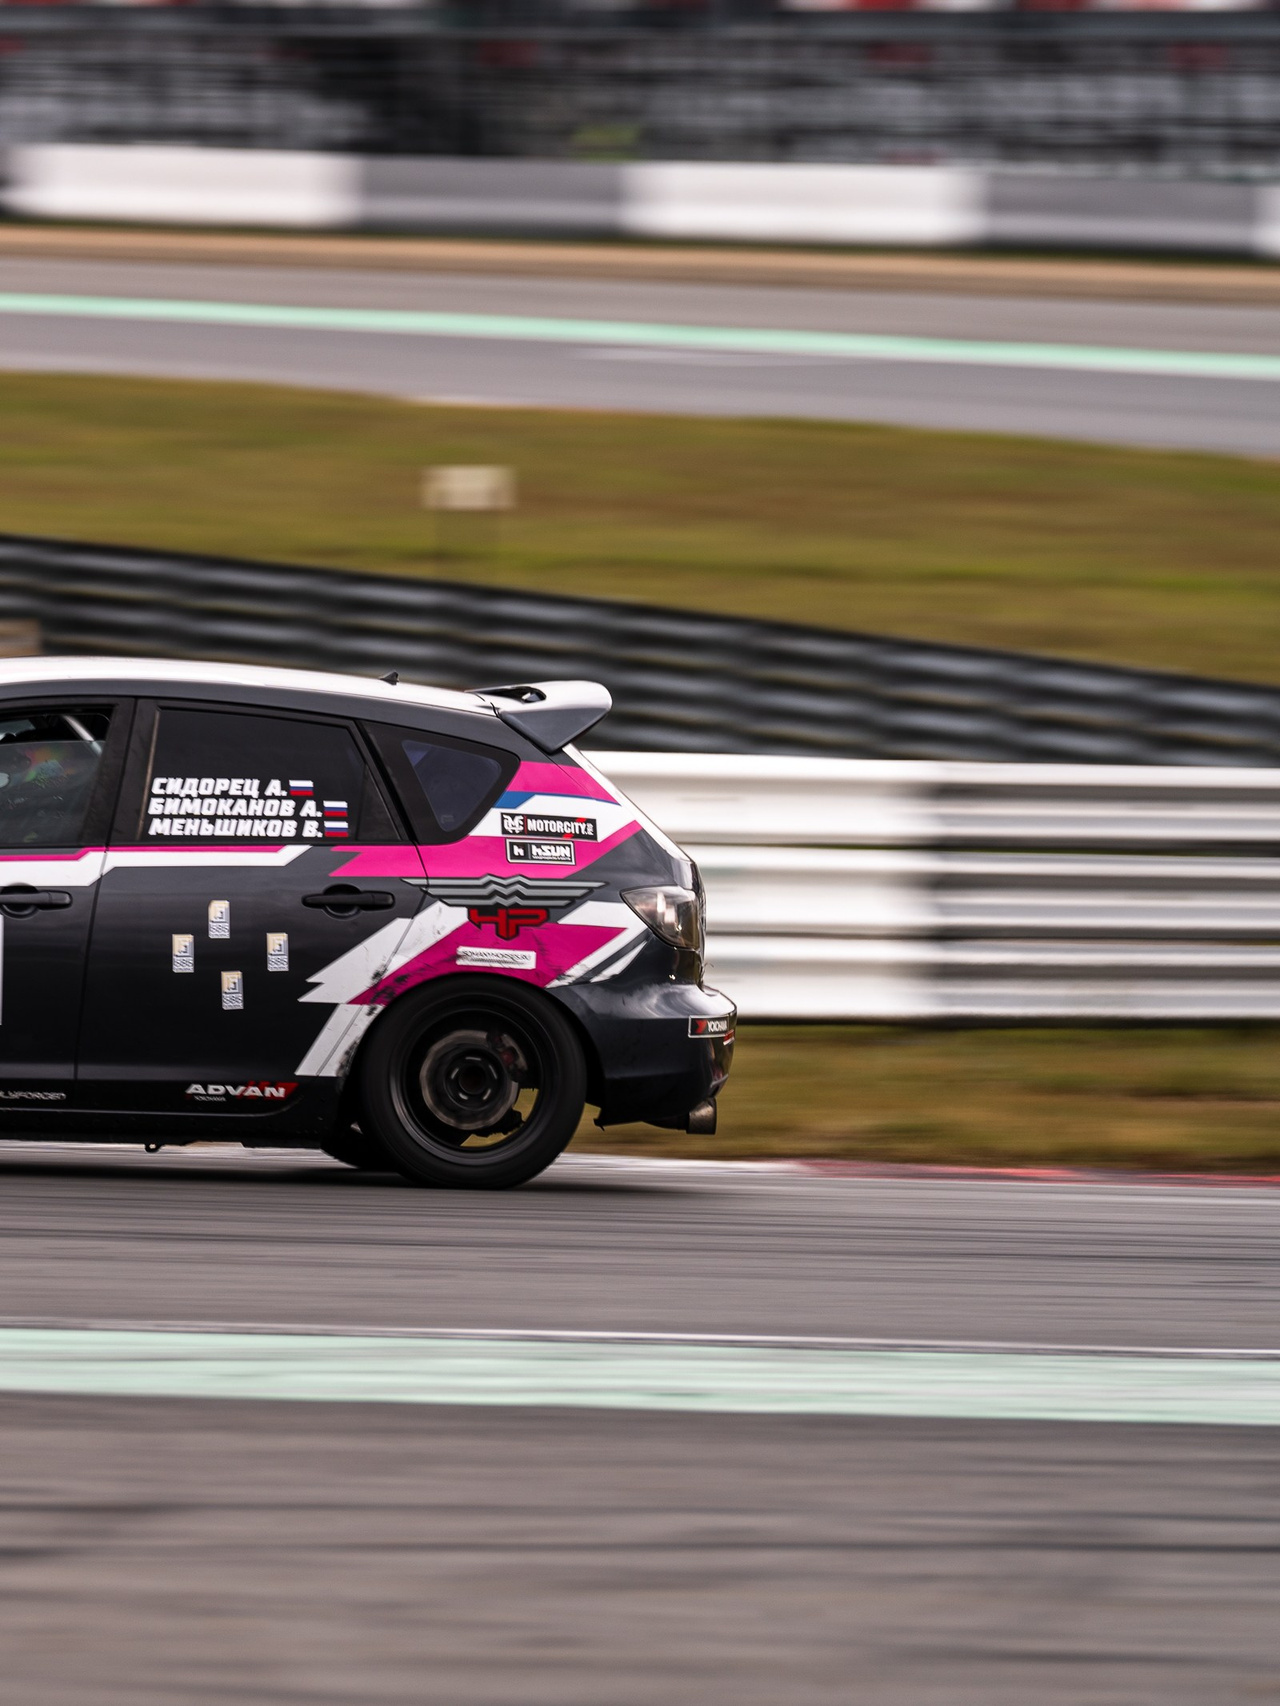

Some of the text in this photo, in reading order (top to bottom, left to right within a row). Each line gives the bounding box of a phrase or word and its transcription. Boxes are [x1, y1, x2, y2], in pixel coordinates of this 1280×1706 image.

[151, 777, 288, 798] СИДОРЕЦ А.
[148, 797, 323, 818] БИМОКАНОВ А.
[148, 817, 323, 838] МЕНЬШИКОВ В.
[185, 1083, 286, 1098] ADVAN
